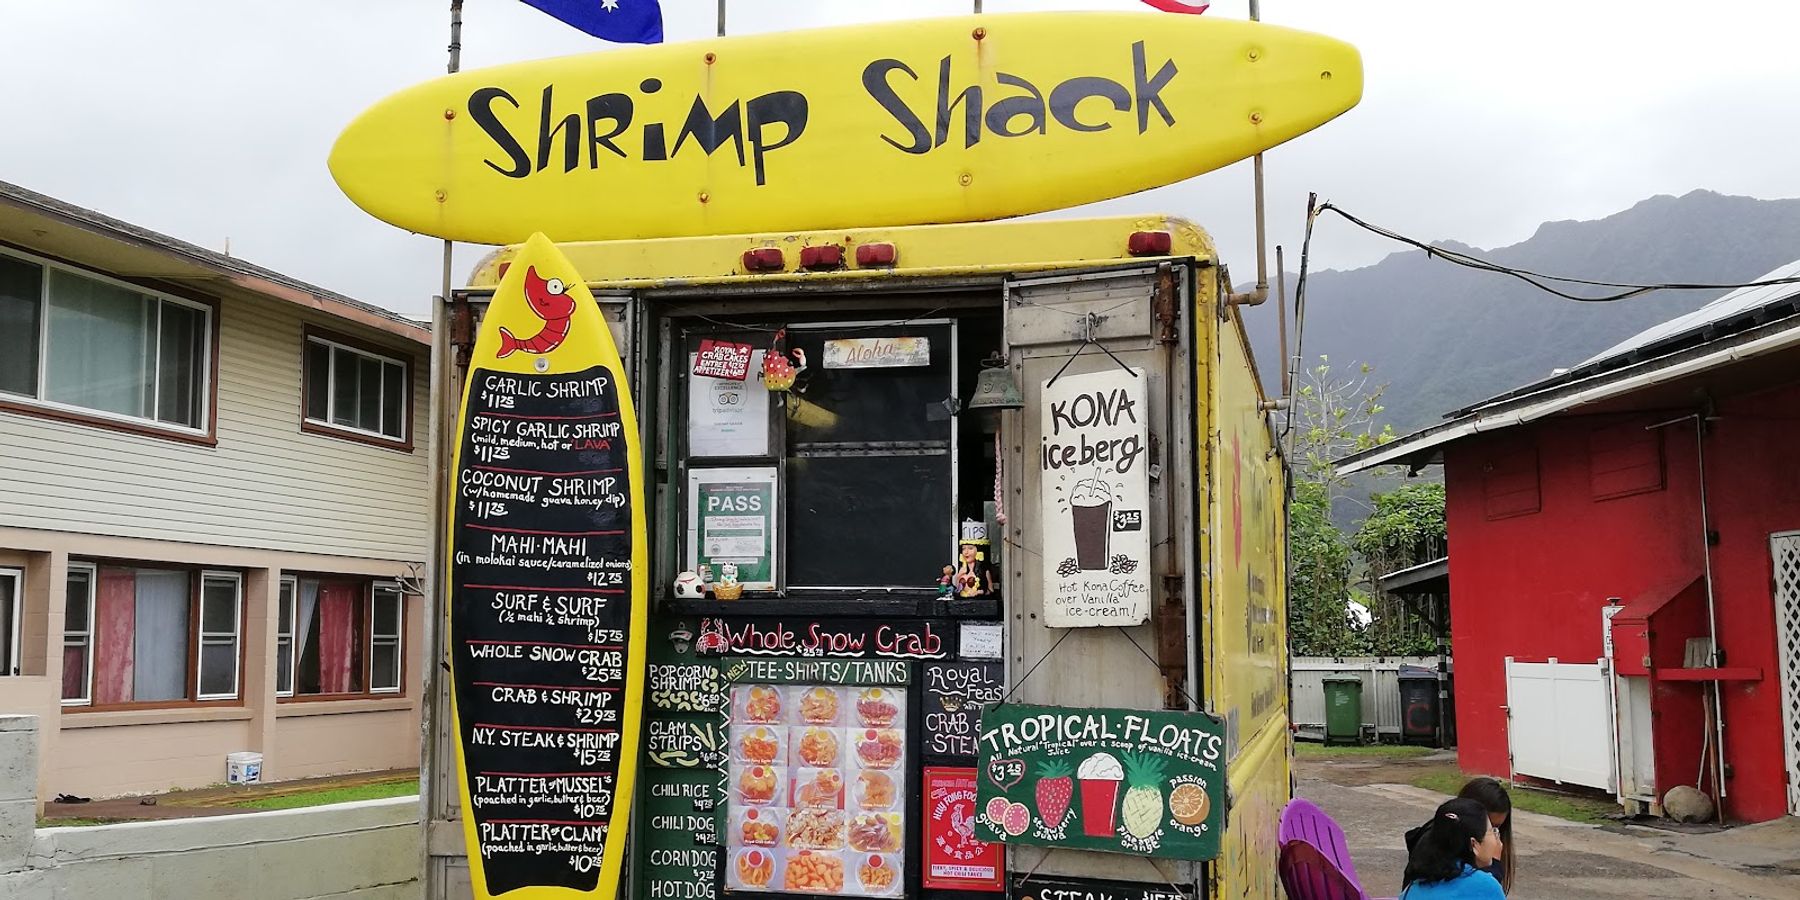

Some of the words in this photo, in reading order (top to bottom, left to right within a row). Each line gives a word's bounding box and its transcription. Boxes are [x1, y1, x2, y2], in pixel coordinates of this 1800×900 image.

[862, 40, 1178, 155] Shack
[714, 345, 737, 355] ROYAL
[845, 339, 894, 363] Aloha
[694, 366, 731, 377] APPETIZER
[700, 360, 728, 369] ENTREE
[485, 376, 542, 396] GARLIC
[546, 377, 607, 398] SHRIMP
[1051, 388, 1136, 435] KONA
[471, 416, 511, 434] SPICY
[517, 422, 570, 439] GARLIC
[572, 423, 620, 439] SHRIMP
[541, 438, 559, 450] hot
[561, 442, 573, 450] or
[462, 469, 543, 493] COCONUT
[548, 477, 616, 496] SHRIMP
[541, 495, 572, 508] guava
[574, 493, 602, 510] honey
[708, 495, 762, 512] PASS
[476, 553, 516, 567] molokai
[1059, 582, 1078, 593] Hot
[1083, 581, 1108, 592] Kona
[491, 592, 538, 611] SURF
[543, 596, 551, 612] &
[555, 597, 607, 616] SURF
[1055, 595, 1077, 605] over
[1081, 593, 1120, 604] Vanilla
[518, 611, 543, 623] mahi
[724, 622, 795, 650] Whole
[801, 622, 865, 651] Snow
[876, 623, 941, 654] Crab
[470, 645, 523, 659] WHOLE
[529, 646, 577, 662] SNOW
[578, 650, 622, 667] CRAB
[649, 664, 711, 679] POPCORN
[727, 660, 748, 679] NEW
[928, 665, 994, 689] Royal
[650, 677, 701, 691] SHRIMP
[491, 687, 537, 705] CRAB
[542, 690, 548, 702] &
[550, 691, 612, 708] SHRIMP
[649, 721, 686, 736] CLAM
[926, 713, 969, 734] CRAB
[472, 727, 496, 746] N.Y.
[500, 731, 556, 748] STEAK
[557, 734, 564, 747] &
[567, 732, 620, 749] SHRIMP
[648, 735, 702, 751] STRIPS
[932, 733, 980, 755] STEA
[1008, 742, 1039, 757] Natural
[1080, 740, 1097, 748] over
[1100, 740, 1106, 748] a
[1110, 740, 1134, 753] scoop
[1138, 743, 1146, 753] of
[1148, 745, 1173, 756] vanilla
[475, 776, 549, 794] PLATTER
[1169, 774, 1207, 789] passion
[519, 795, 527, 804] in
[652, 784, 680, 796] CHILI
[682, 784, 710, 798] RICE
[943, 791, 962, 806] FONG
[652, 816, 683, 830] CHILI
[686, 816, 715, 833] DOG
[975, 813, 1007, 841] guava
[1033, 808, 1077, 834] strawberry
[1170, 819, 1208, 837] orange
[480, 823, 551, 841] PLATTER
[1033, 830, 1067, 841] guava
[527, 843, 535, 852] in
[1121, 839, 1160, 854] orange
[651, 880, 682, 898] HOT
[685, 881, 716, 900] DOG
